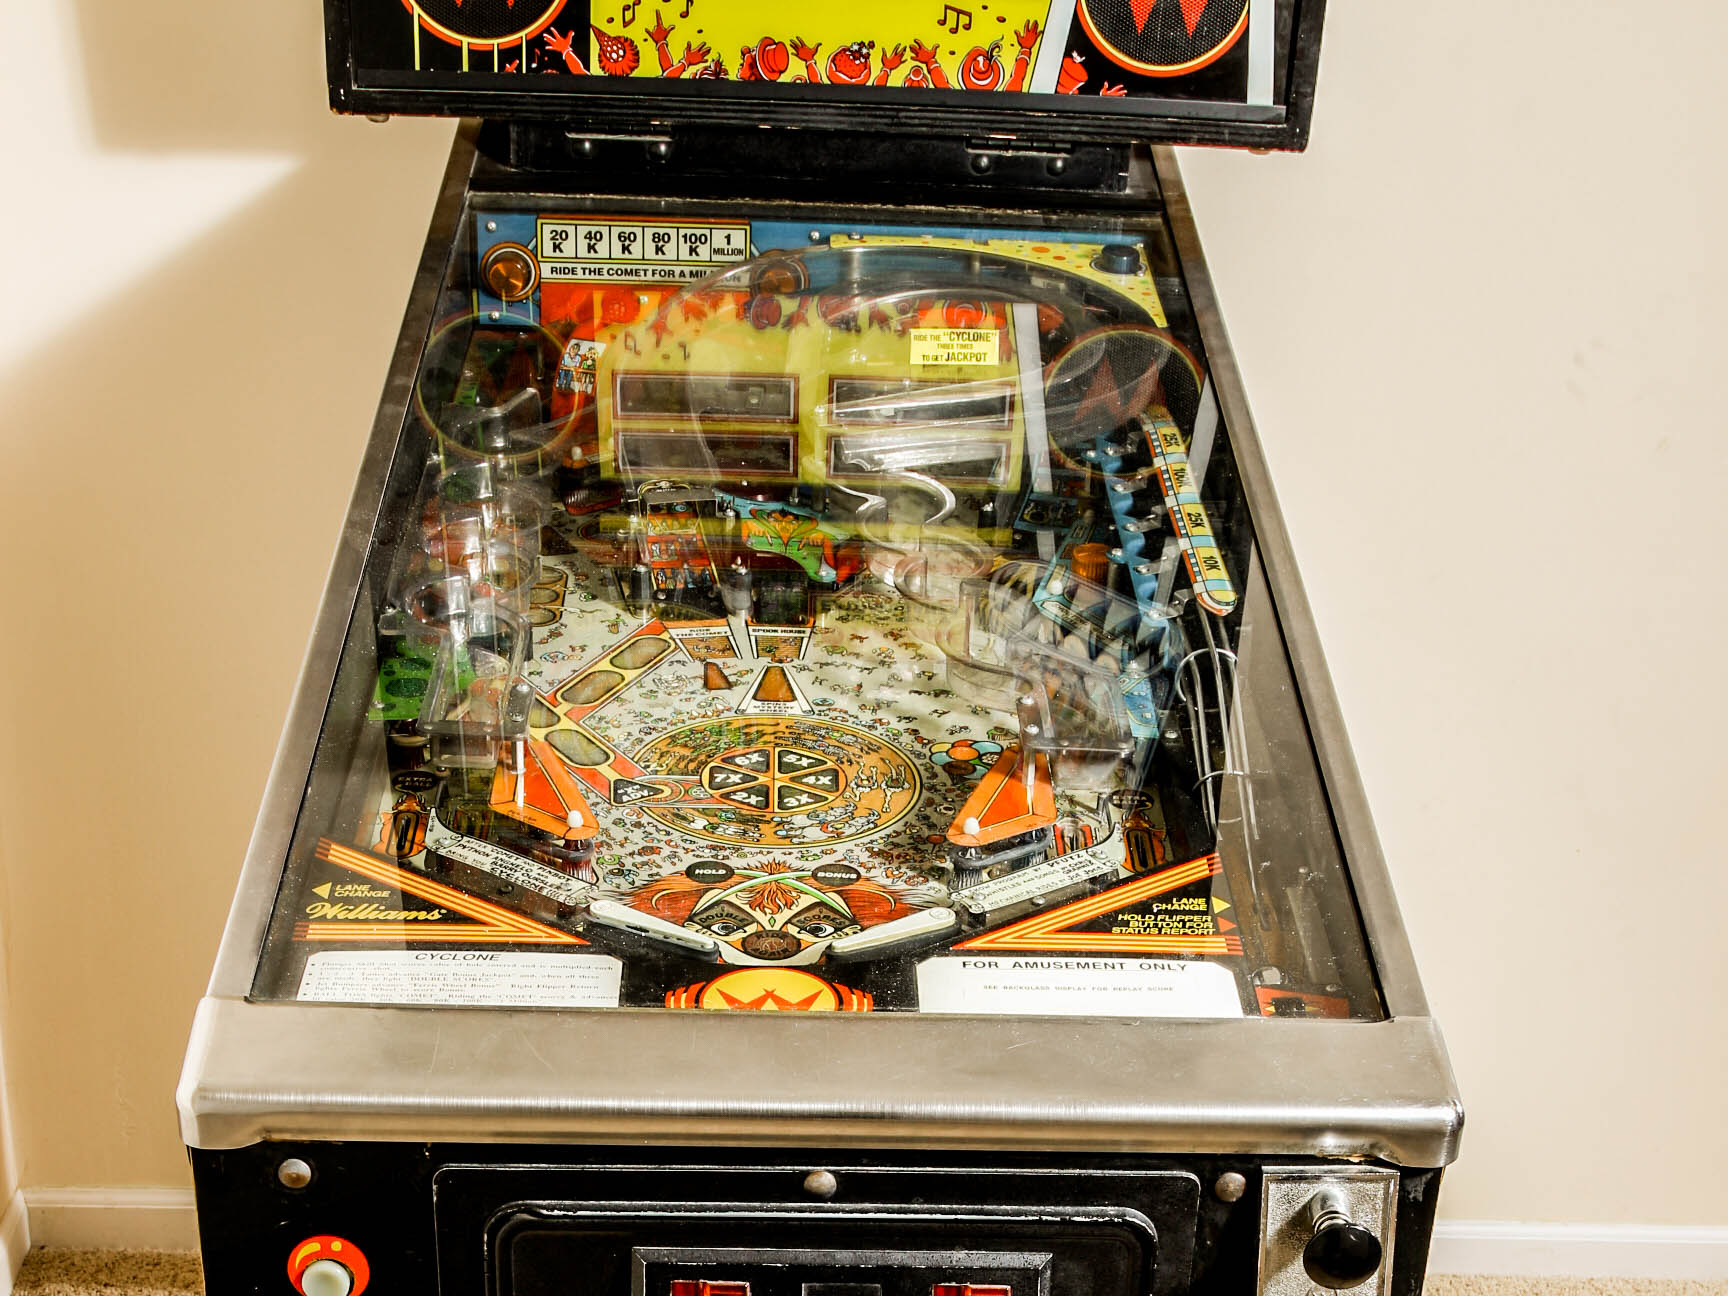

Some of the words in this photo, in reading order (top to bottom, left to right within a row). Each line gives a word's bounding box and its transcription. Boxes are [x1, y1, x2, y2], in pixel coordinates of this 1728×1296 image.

[550, 230, 569, 241] 20
[584, 231, 603, 242] 40
[618, 232, 637, 243] 60
[652, 232, 671, 244] 80
[682, 234, 708, 244] 100
[724, 234, 731, 246] 1
[553, 242, 563, 253] K
[588, 243, 598, 254] K
[622, 244, 633, 255] K
[655, 244, 666, 256] K
[689, 245, 700, 256] K
[713, 248, 744, 256] MILLION
[550, 266, 578, 276] RIDE
[580, 267, 604, 276] THE
[606, 267, 649, 277] COMET
[652, 268, 675, 278] FOR
[678, 268, 686, 278] A
[945, 352, 988, 362] JACKPOT
[1163, 432, 1180, 447] 25K
[1187, 512, 1205, 528] 25K
[1202, 556, 1221, 571] 10K
[734, 752, 765, 766] 6X
[783, 754, 816, 767] 5X
[714, 774, 744, 783] 7X
[802, 776, 834, 784] 4X
[622, 790, 654, 802] ADV.
[730, 792, 764, 805] 2X
[784, 793, 815, 806] 3X
[456, 843, 490, 858] PYTHON
[490, 861, 519, 874] BARRY
[491, 848, 521, 861] COMET
[538, 866, 574, 882] PINBOT
[817, 871, 857, 879] BONUS
[336, 884, 371, 892] LANE
[306, 902, 443, 922] Williams
[698, 912, 749, 924] DOUBLE
[799, 914, 846, 926] SCORES
[415, 953, 501, 962] CYCLONE
[962, 961, 999, 969] FOR
[1012, 962, 1126, 970] AMUSEMENT
[1139, 962, 1187, 972] ONLY
